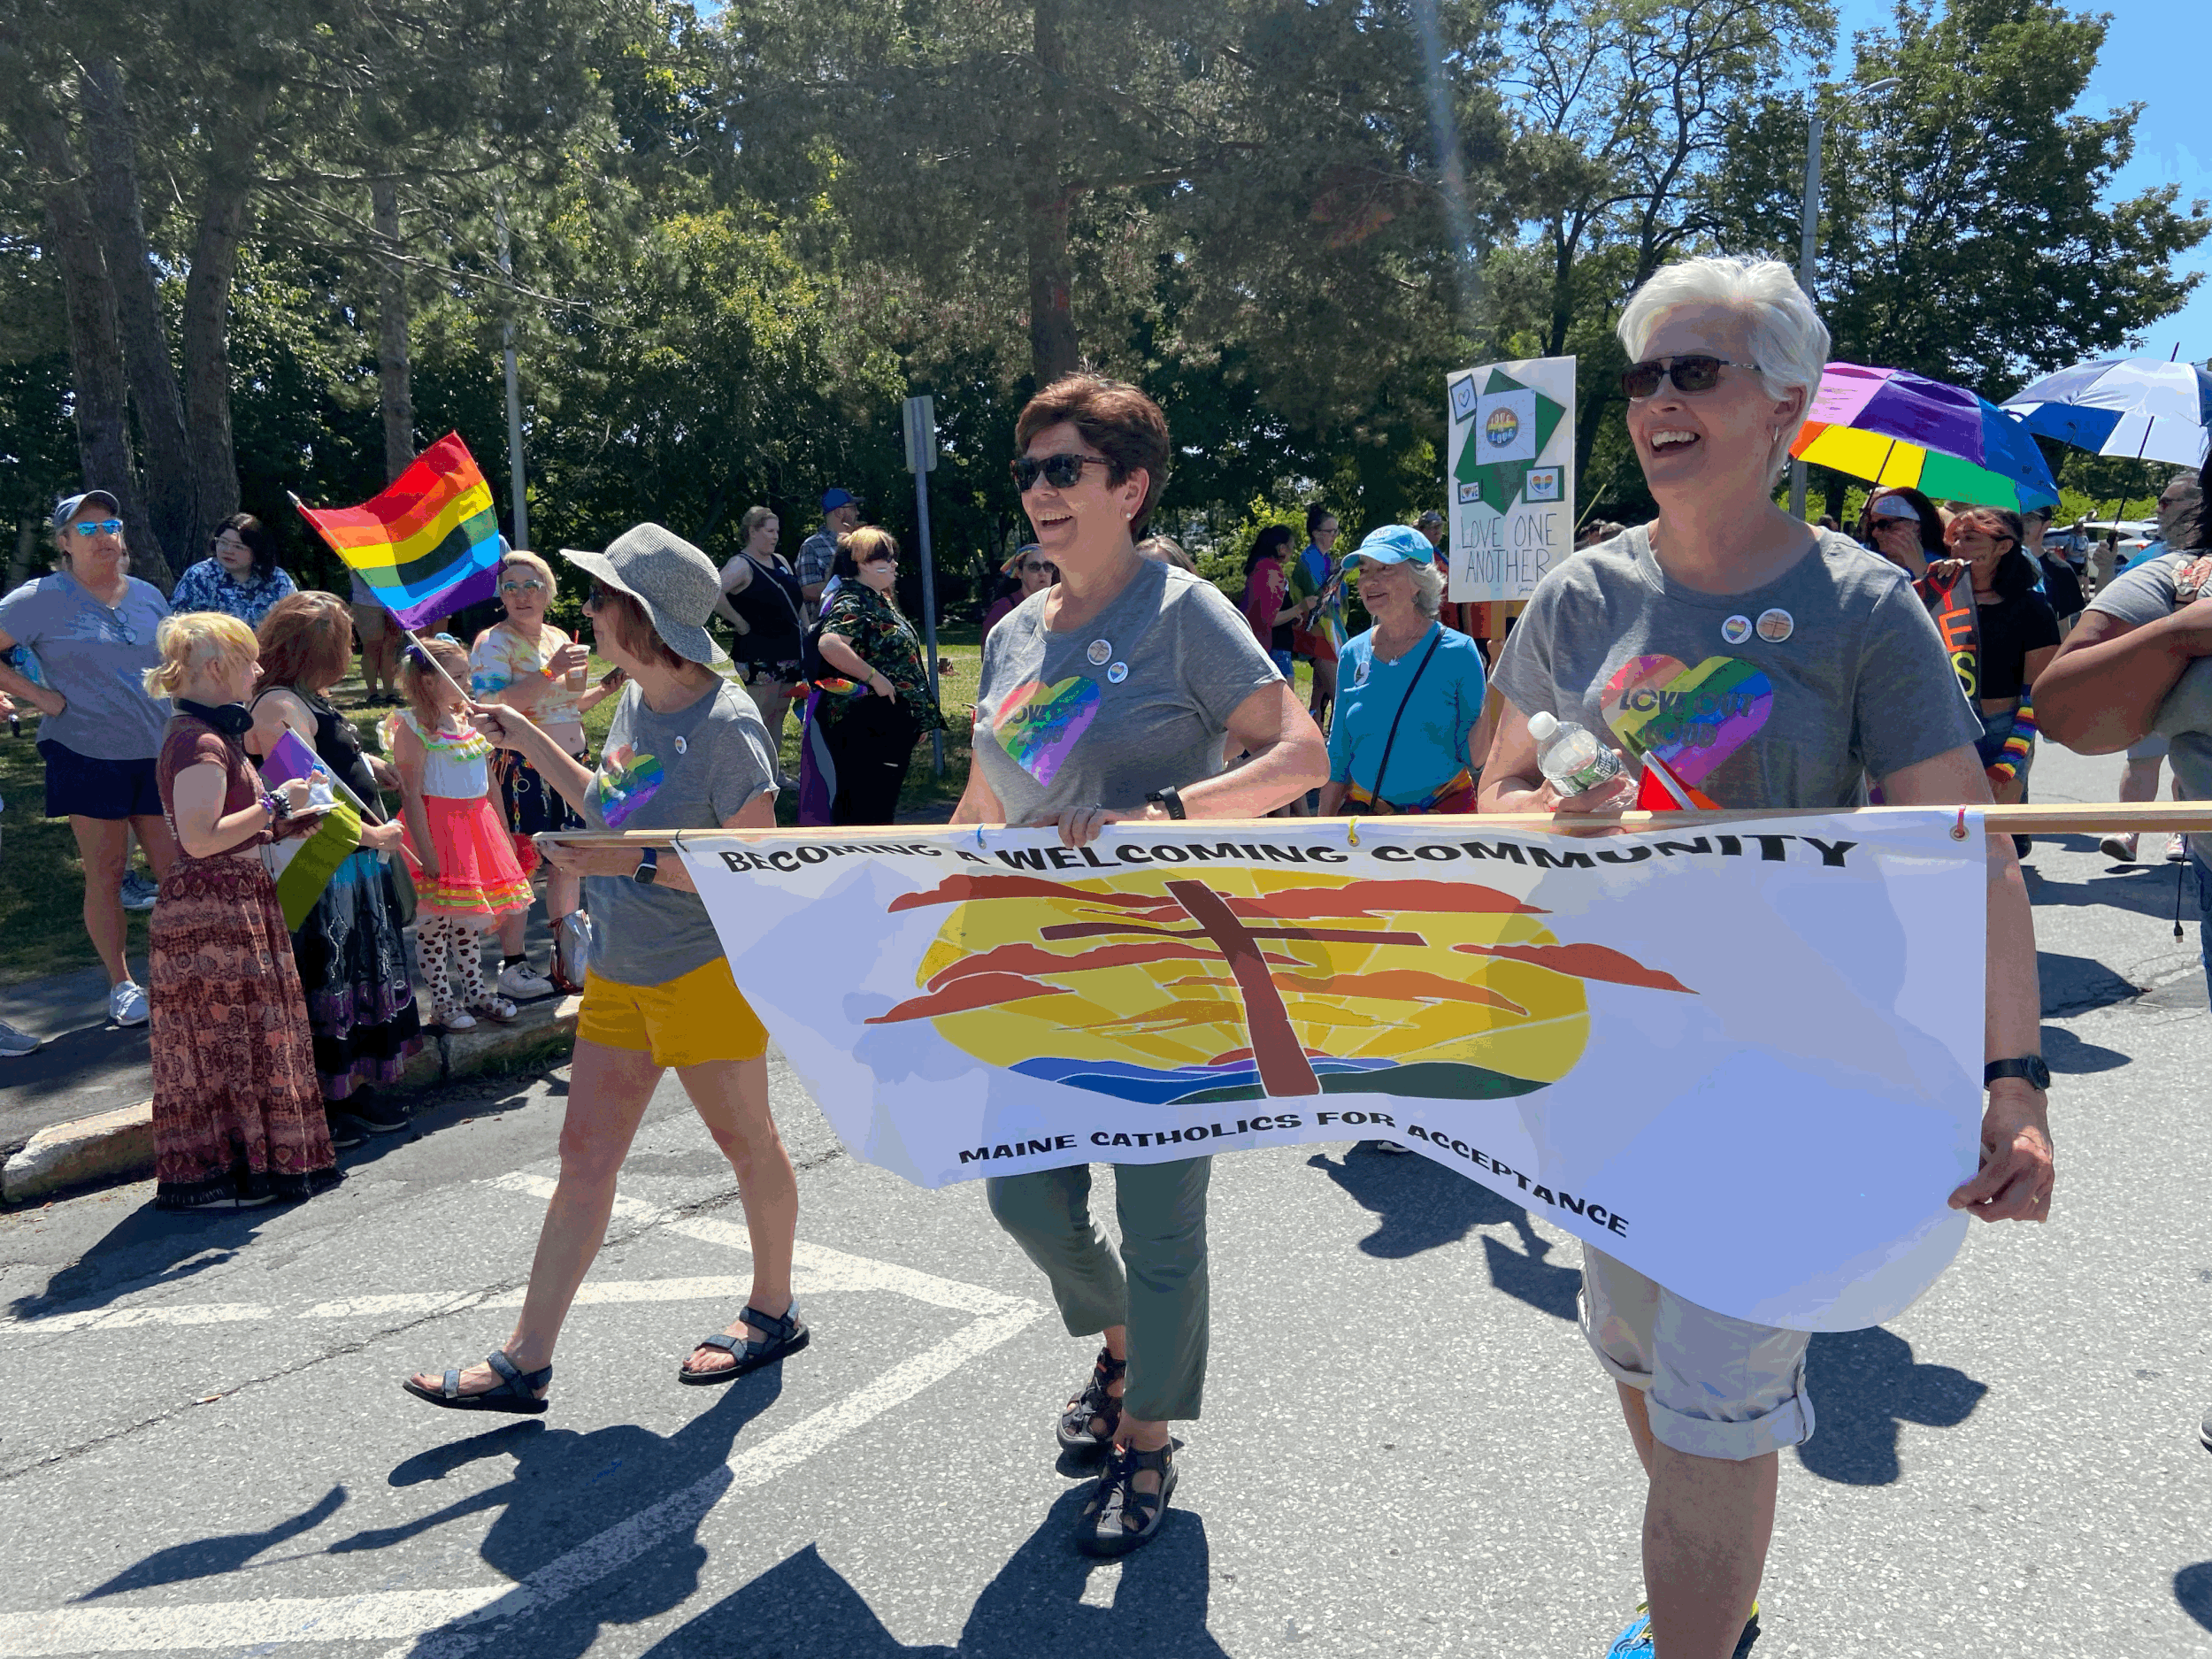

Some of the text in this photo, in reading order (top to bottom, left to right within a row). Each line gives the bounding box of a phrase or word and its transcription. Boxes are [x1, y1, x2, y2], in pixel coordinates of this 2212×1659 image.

[1460, 513, 1557, 549] LOVE ONE
[1465, 549, 1550, 583] ANOTHER
[1927, 564, 1977, 697] YES
[1003, 704, 1049, 726] OVE
[1618, 688, 1756, 718] LOVE OUT
[1643, 721, 1718, 749] LOUD
[718, 834, 1859, 872] BECOMING A WELCOMING COMMUNITY
[958, 1110, 1629, 1238] MAINE CATHOLICS FOR ACCEPTANCE
